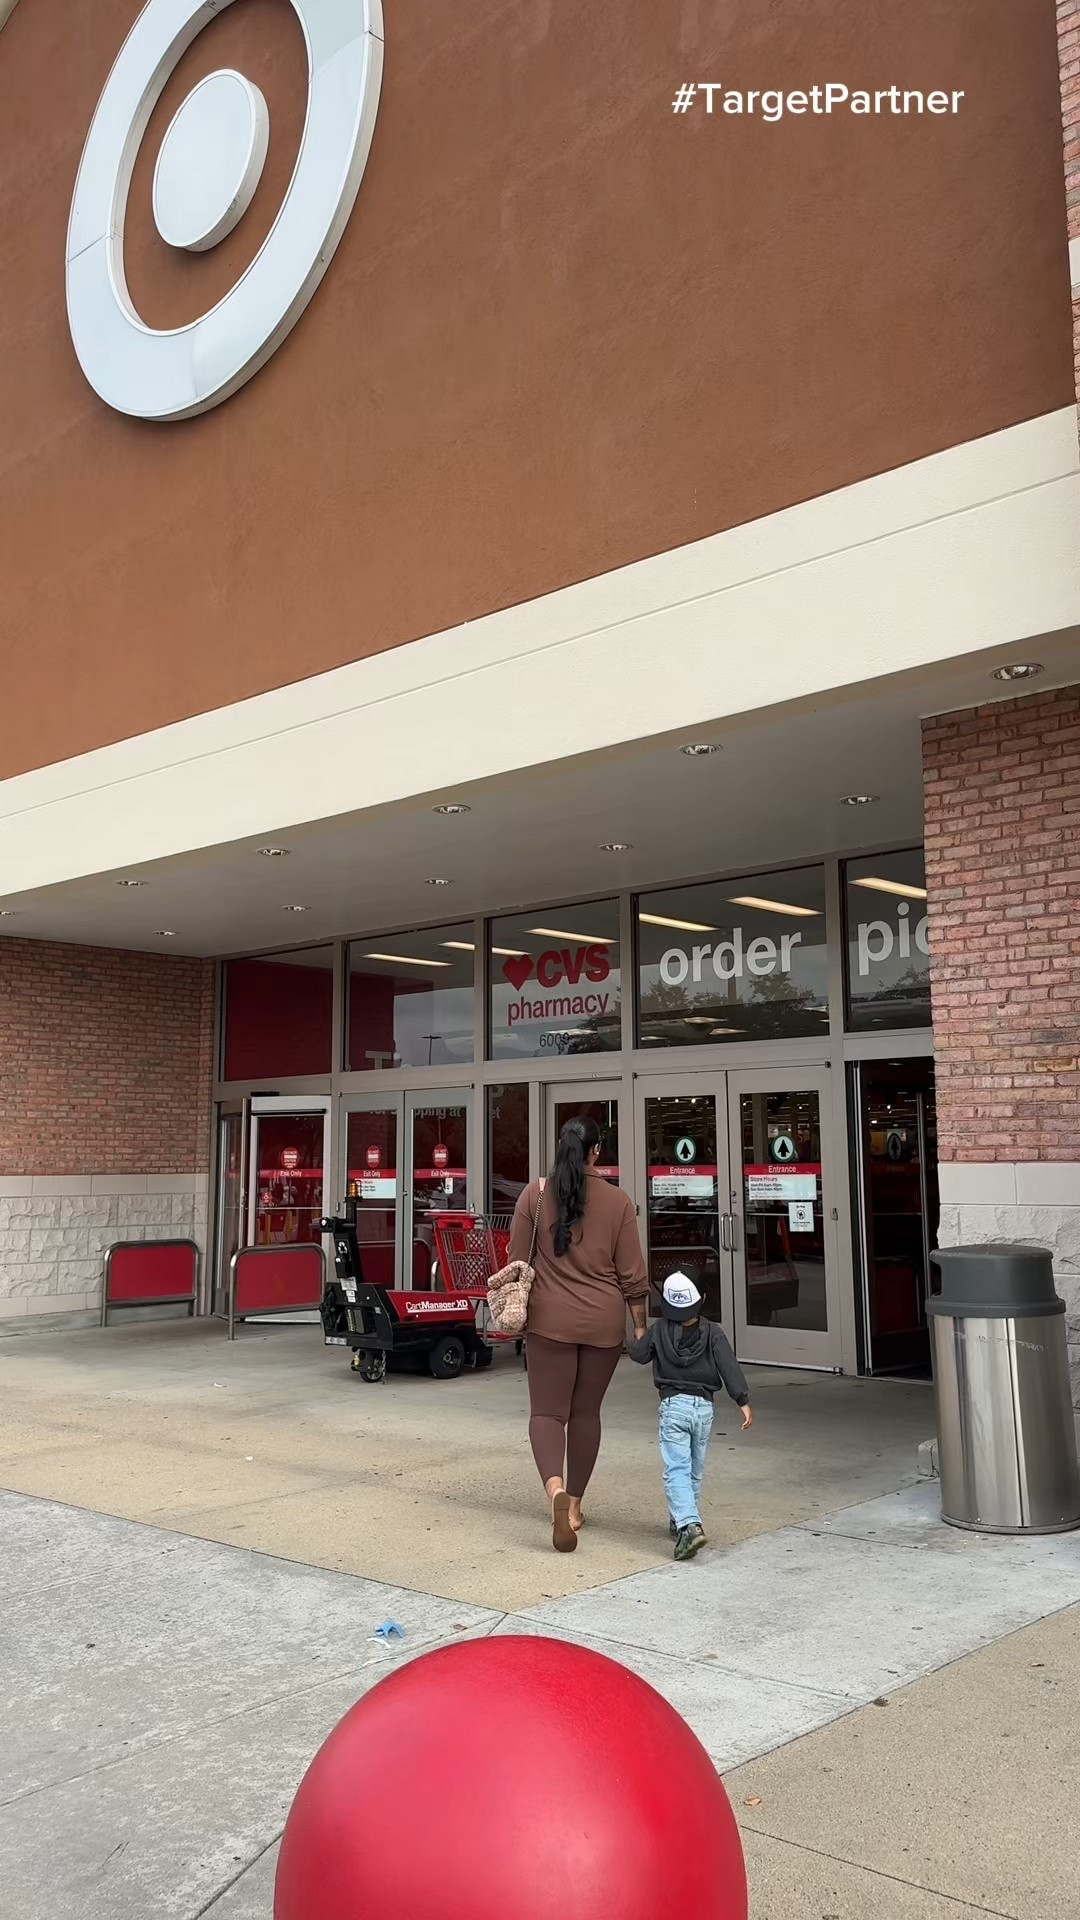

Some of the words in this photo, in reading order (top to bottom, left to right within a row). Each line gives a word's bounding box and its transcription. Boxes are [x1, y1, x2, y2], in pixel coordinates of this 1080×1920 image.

[659, 927, 802, 986] order
[536, 943, 610, 988] CVS
[507, 992, 610, 1027] pharmacy
[290, 1169, 302, 1178] Only
[669, 1166, 696, 1175] Entrance
[768, 1165, 797, 1173] Entrance
[405, 1300, 456, 1311] CartManager
[456, 1299, 469, 1308] XD
